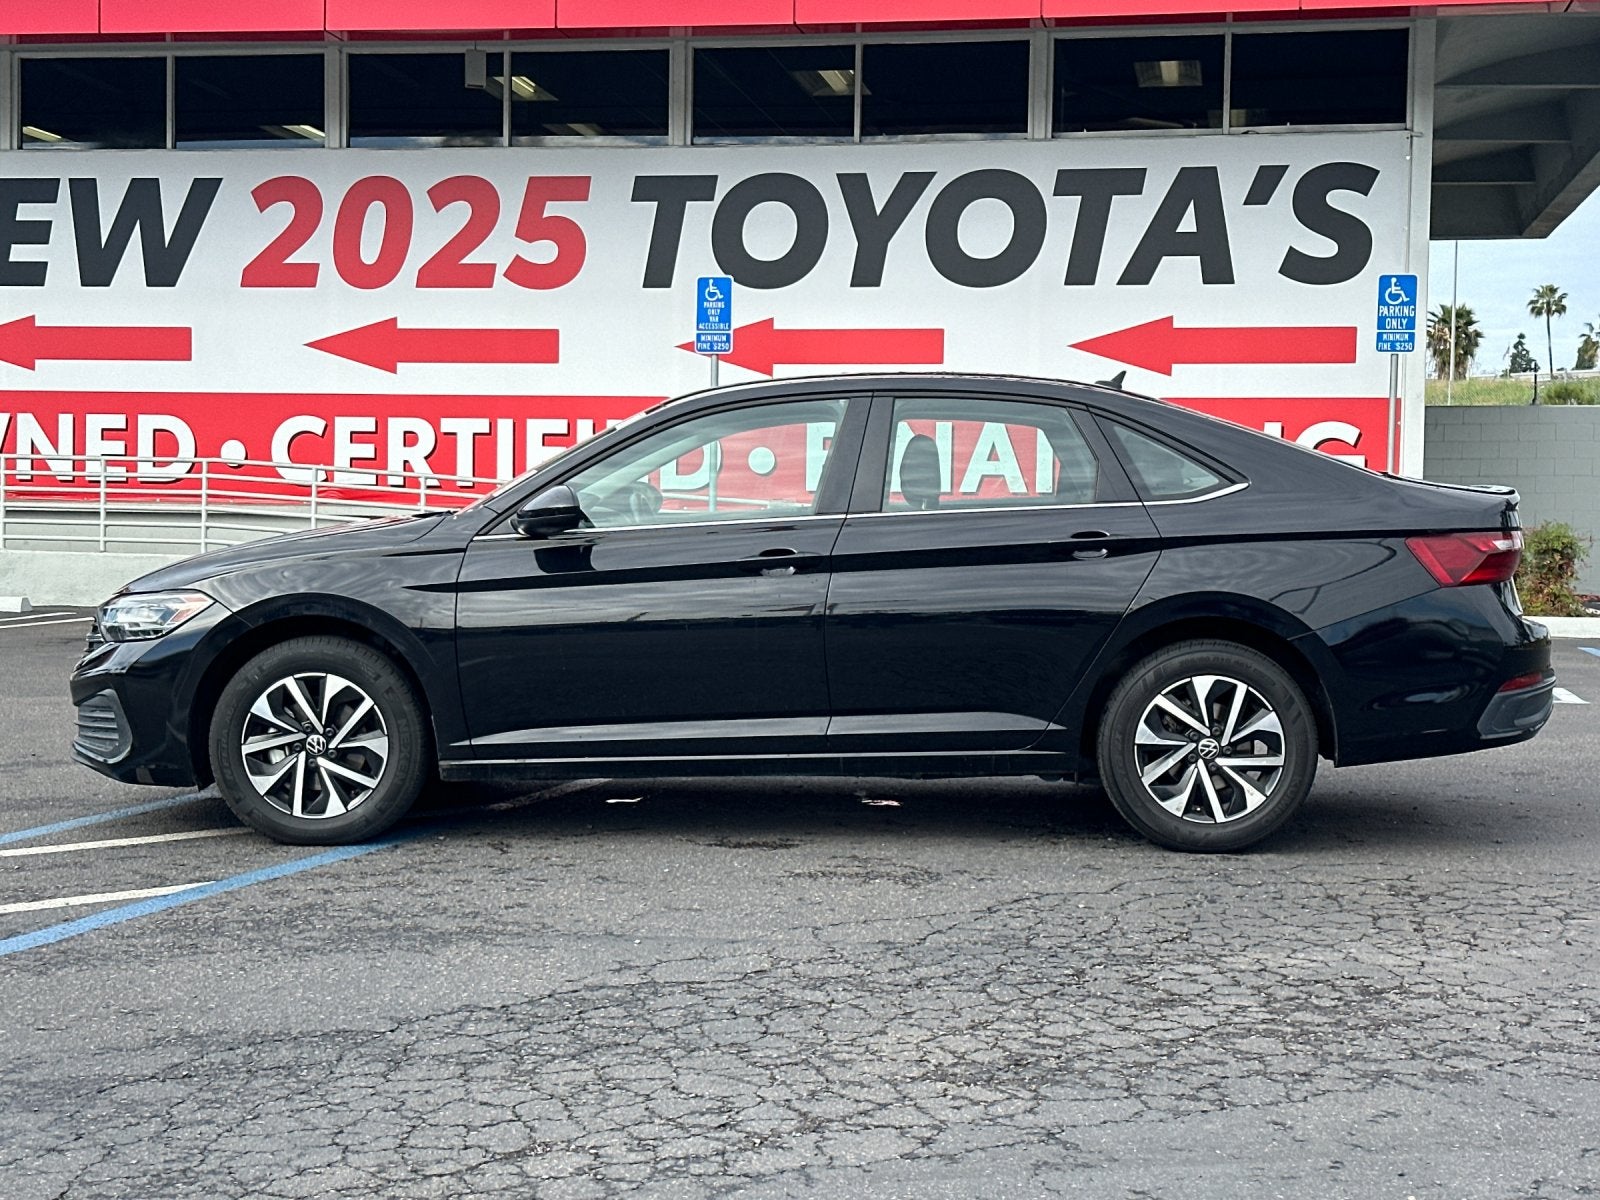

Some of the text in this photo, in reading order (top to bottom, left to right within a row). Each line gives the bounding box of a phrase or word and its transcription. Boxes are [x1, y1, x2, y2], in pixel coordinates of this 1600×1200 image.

[240, 175, 592, 290] 2025
[630, 161, 1381, 290] TOYOTA'S
[1379, 305, 1415, 317] PARKING
[1385, 318, 1408, 329] ONLY
[1382, 333, 1409, 341] MINIMUM
[1378, 342, 1413, 351] FINE $250
[0, 412, 197, 483] NED
